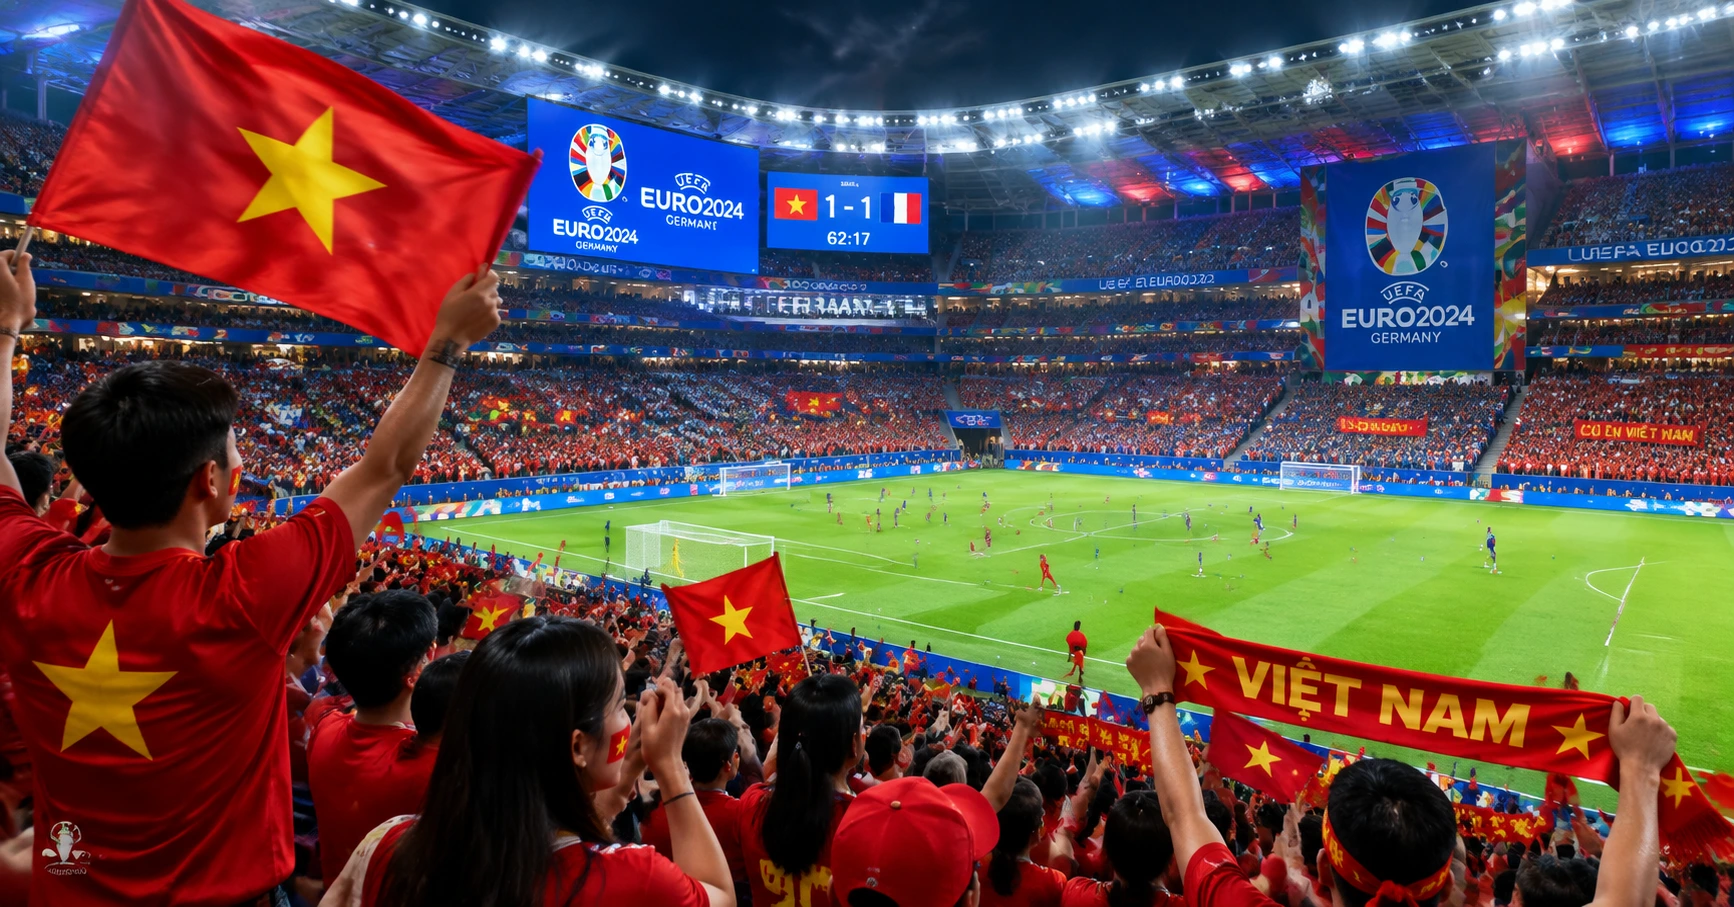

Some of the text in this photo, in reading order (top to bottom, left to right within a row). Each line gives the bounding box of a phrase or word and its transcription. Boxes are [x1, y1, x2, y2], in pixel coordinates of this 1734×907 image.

[641, 187, 744, 220] EURO2024
[825, 194, 835, 218] 1
[861, 196, 871, 220] 1
[553, 218, 639, 244] EURO2024
[827, 231, 871, 246] 62:17
[1382, 285, 1426, 302] UEFA
[1341, 304, 1475, 329] EURO2024
[1371, 331, 1442, 344] GERMANY
[1231, 655, 1531, 748] VIỆT NAM
